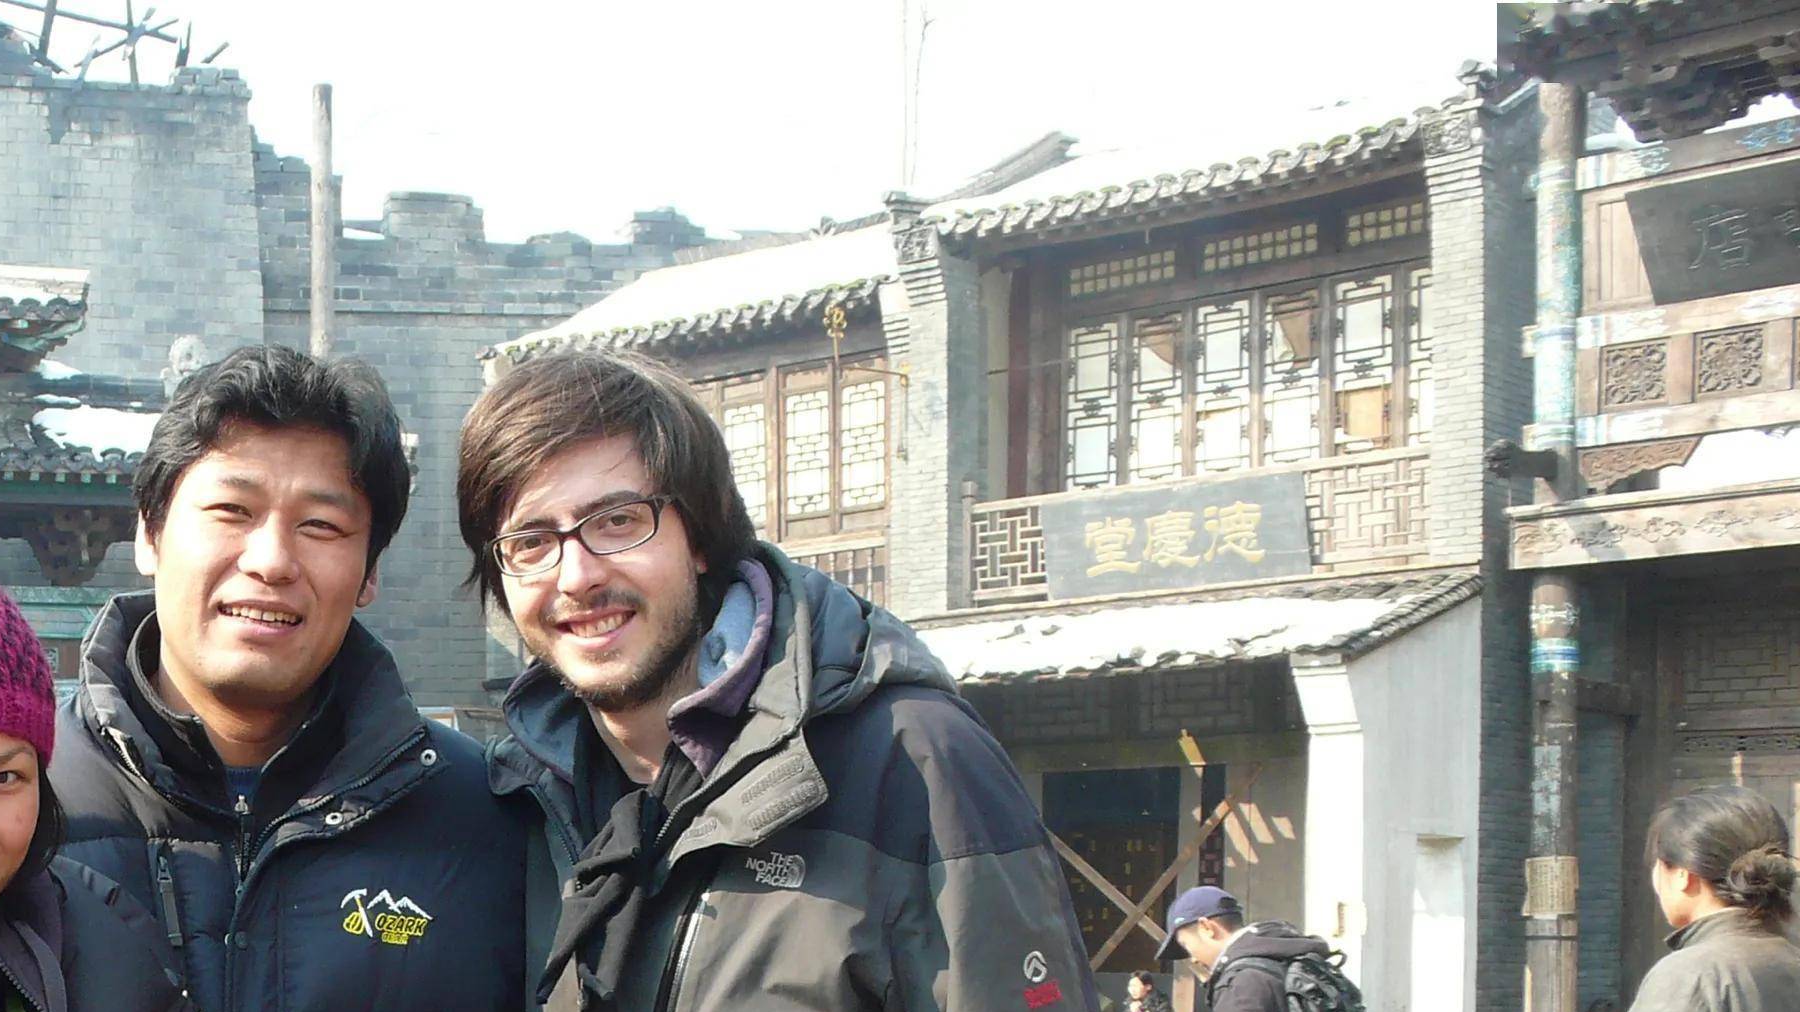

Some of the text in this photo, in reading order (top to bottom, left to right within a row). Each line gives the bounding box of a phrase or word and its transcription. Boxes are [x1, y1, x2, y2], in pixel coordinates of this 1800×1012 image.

[745, 857, 790, 876] NORTH
[770, 851, 794, 867] THE
[755, 871, 787, 887] FACE
[375, 913, 428, 937] OZARK
